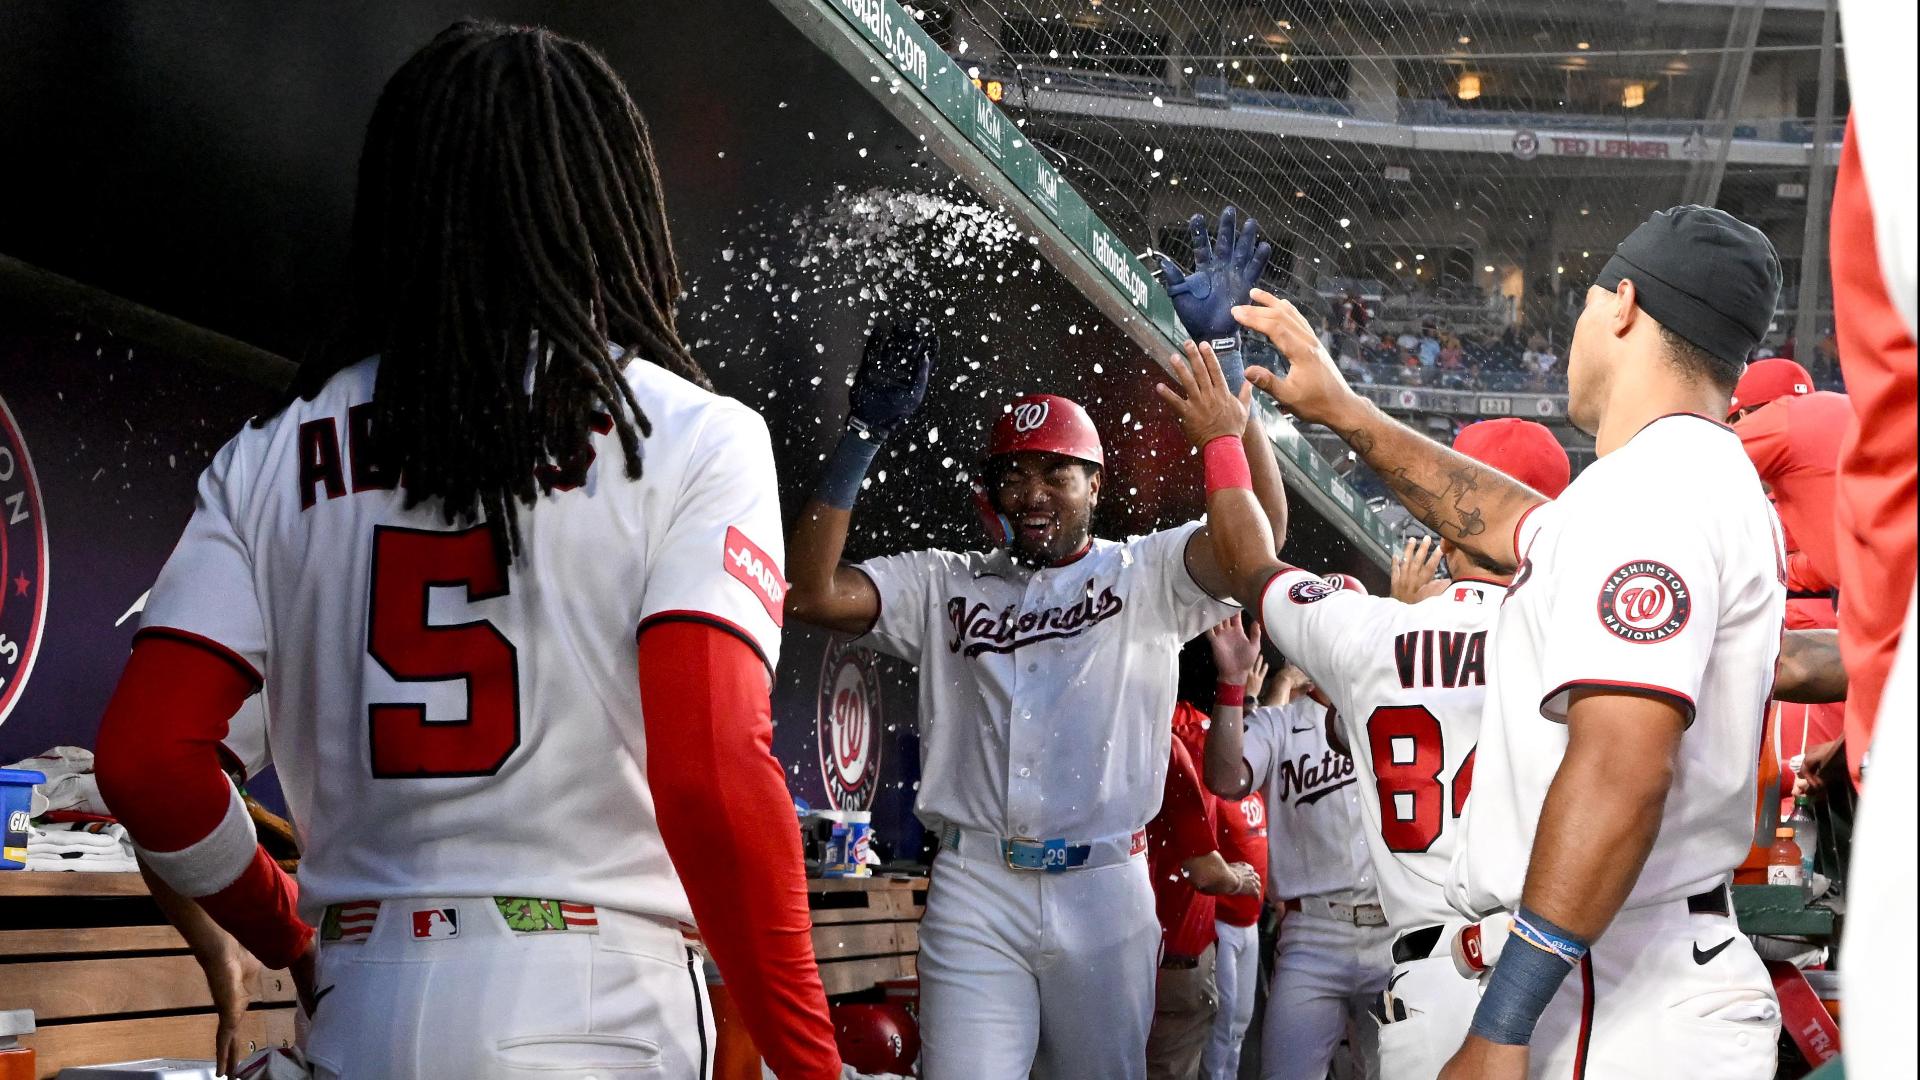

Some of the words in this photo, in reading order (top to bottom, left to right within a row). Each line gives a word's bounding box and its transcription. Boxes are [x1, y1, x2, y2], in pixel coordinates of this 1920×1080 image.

[976, 99, 1001, 145] MGM
[1552, 138, 1590, 155] TED
[1037, 162, 1058, 202] MGM
[1092, 229, 1148, 310] nationals.com
[1014, 401, 1049, 432] W
[727, 547, 785, 604] AARP
[1604, 563, 1687, 599] WASHINGTON
[947, 577, 1123, 655] Nationals
[1621, 584, 1666, 623] W
[1604, 614, 1680, 640] NATIONALS
[367, 524, 521, 779] 5
[1394, 629, 1488, 689] VIVA
[1240, 797, 1263, 826] W
[1047, 848, 1066, 866] 29
